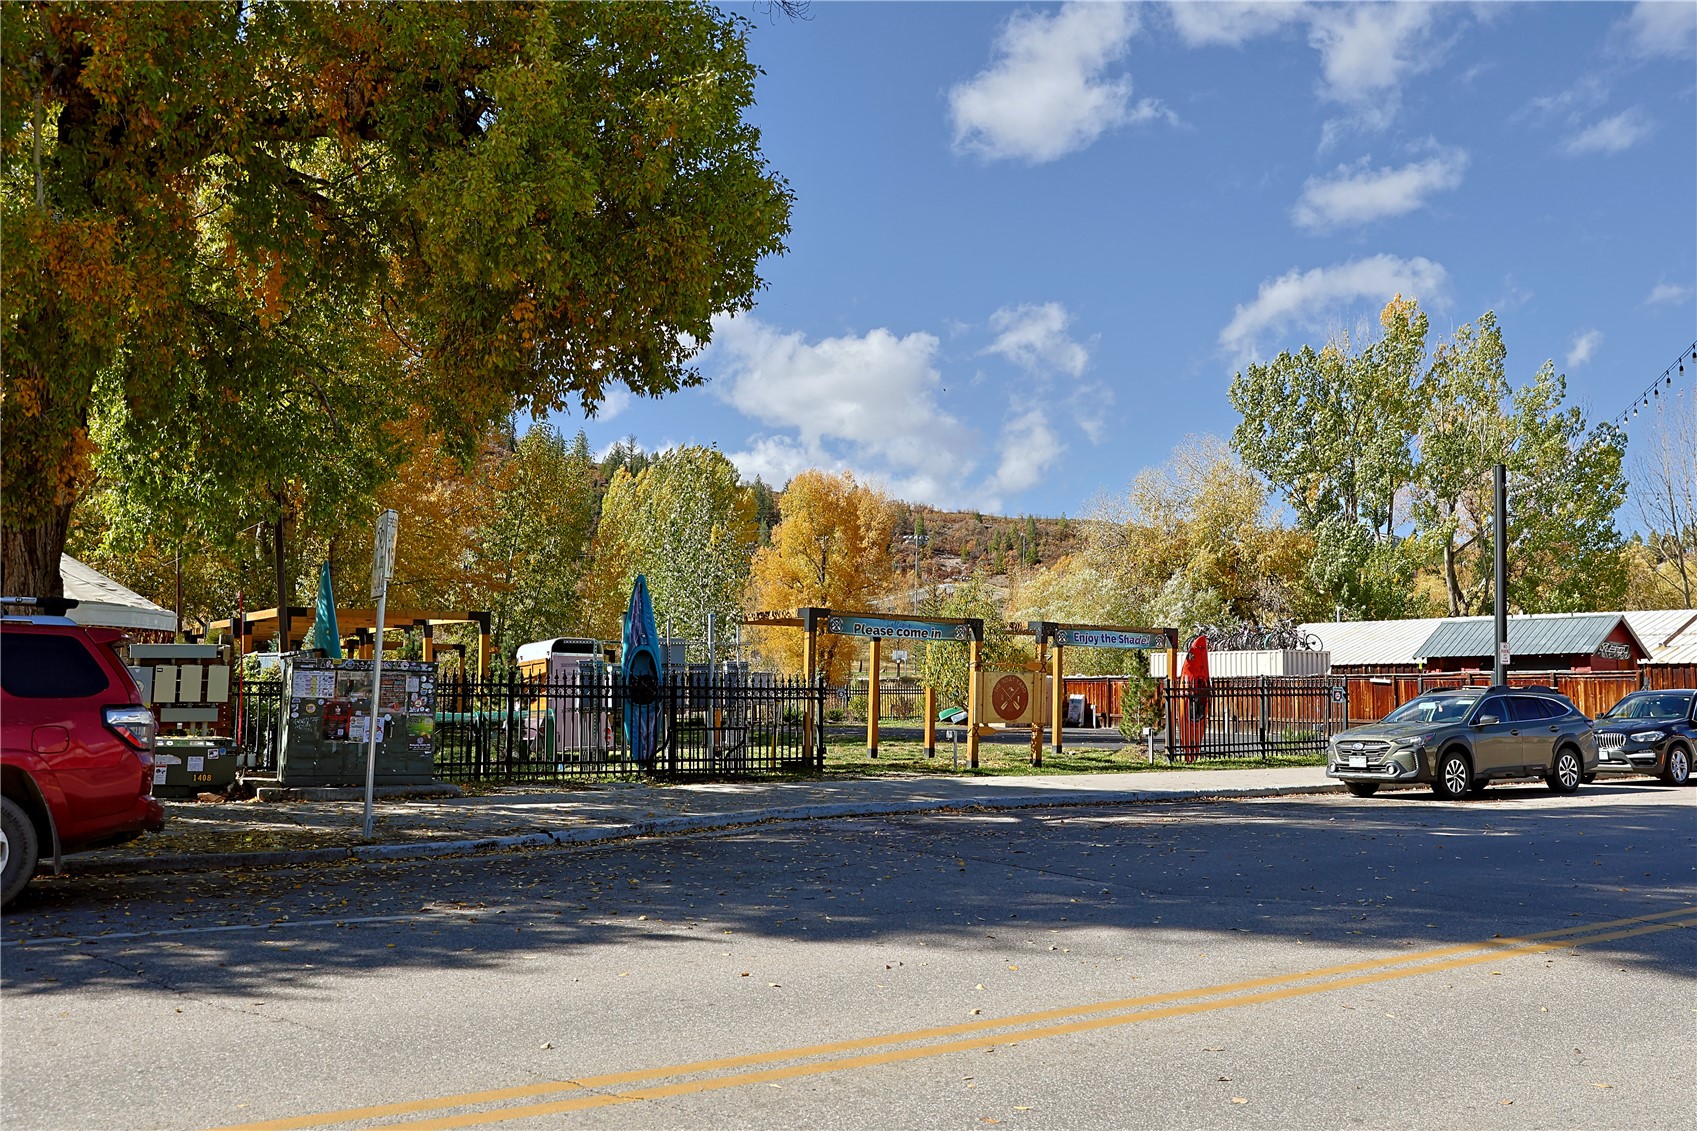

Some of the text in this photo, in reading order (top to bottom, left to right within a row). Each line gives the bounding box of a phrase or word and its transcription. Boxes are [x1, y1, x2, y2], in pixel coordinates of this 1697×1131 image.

[854, 623, 894, 636] Please
[896, 627, 928, 639] come
[930, 627, 942, 639] in
[1073, 632, 1151, 645] Enjoy the Shade!
[193, 774, 212, 782] 1408
